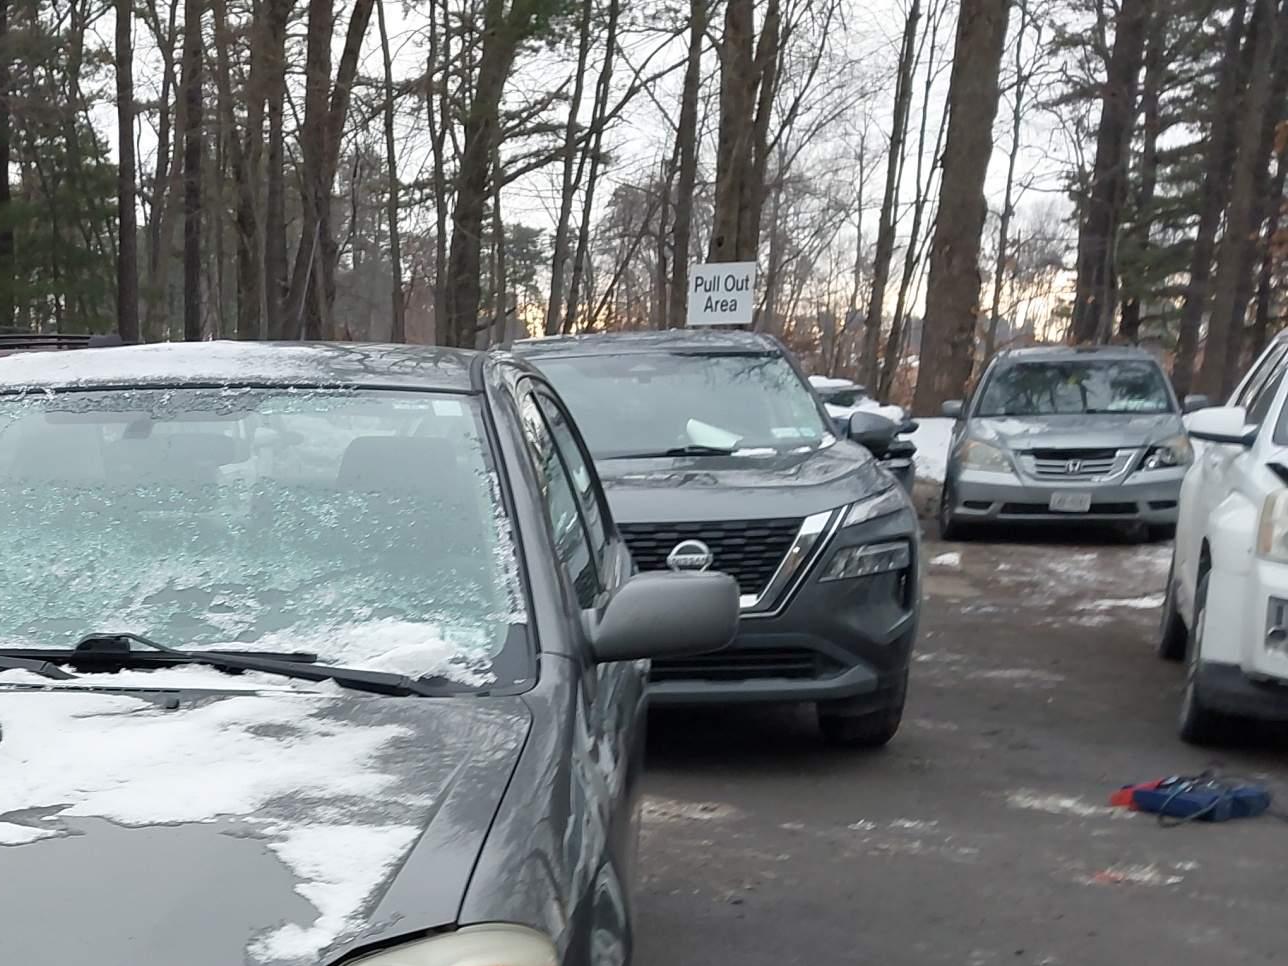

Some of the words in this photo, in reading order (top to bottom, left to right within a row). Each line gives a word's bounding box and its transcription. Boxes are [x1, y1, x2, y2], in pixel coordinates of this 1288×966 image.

[694, 275, 720, 293] Pull
[724, 274, 750, 292] Out
[703, 295, 738, 312] Area
